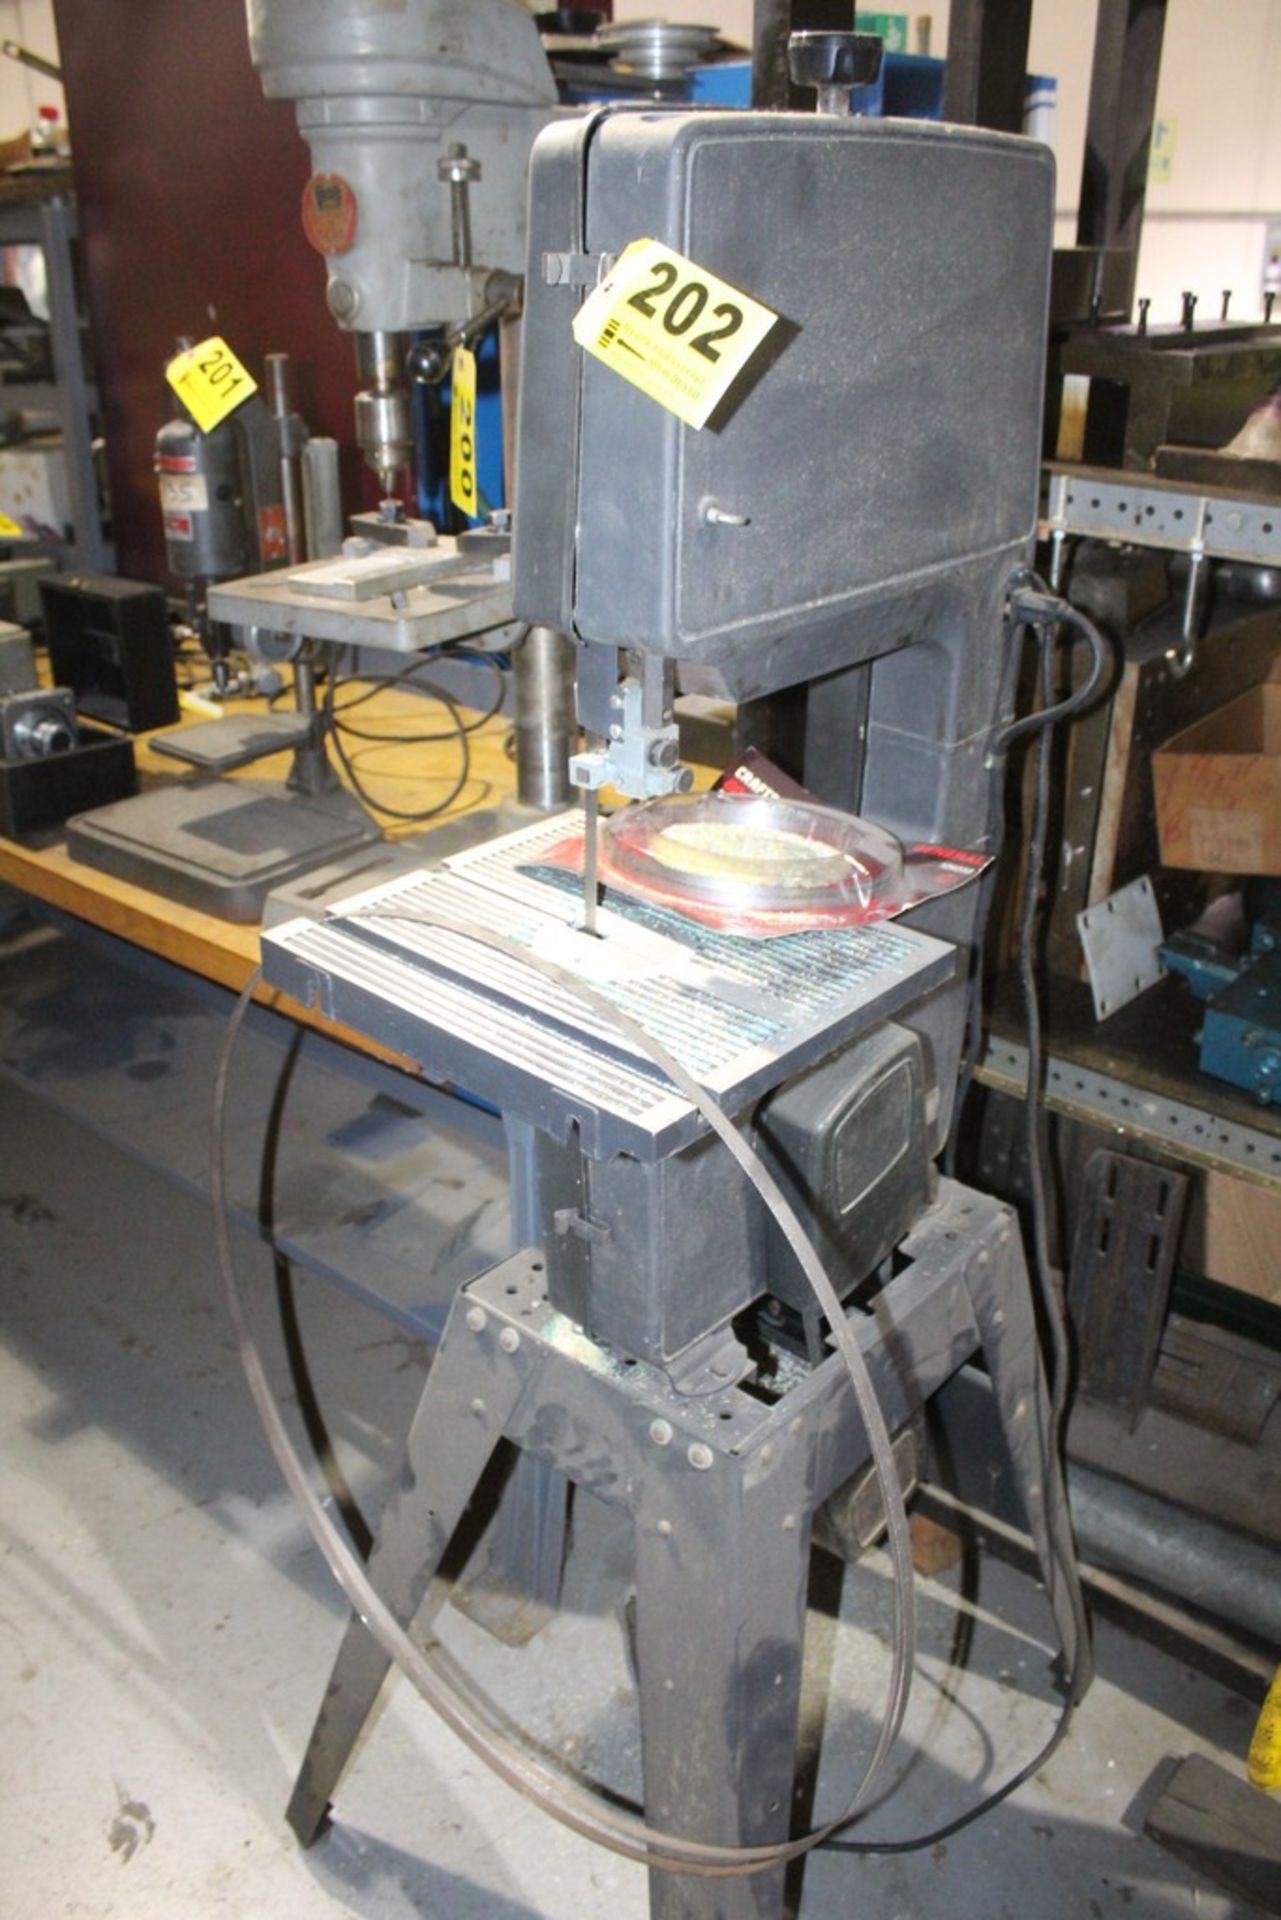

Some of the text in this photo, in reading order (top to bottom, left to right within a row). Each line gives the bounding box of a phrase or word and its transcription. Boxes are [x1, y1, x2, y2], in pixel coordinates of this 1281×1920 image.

[627, 261, 743, 364] 202
[198, 349, 243, 399] 201
[459, 394, 473, 498] 200
